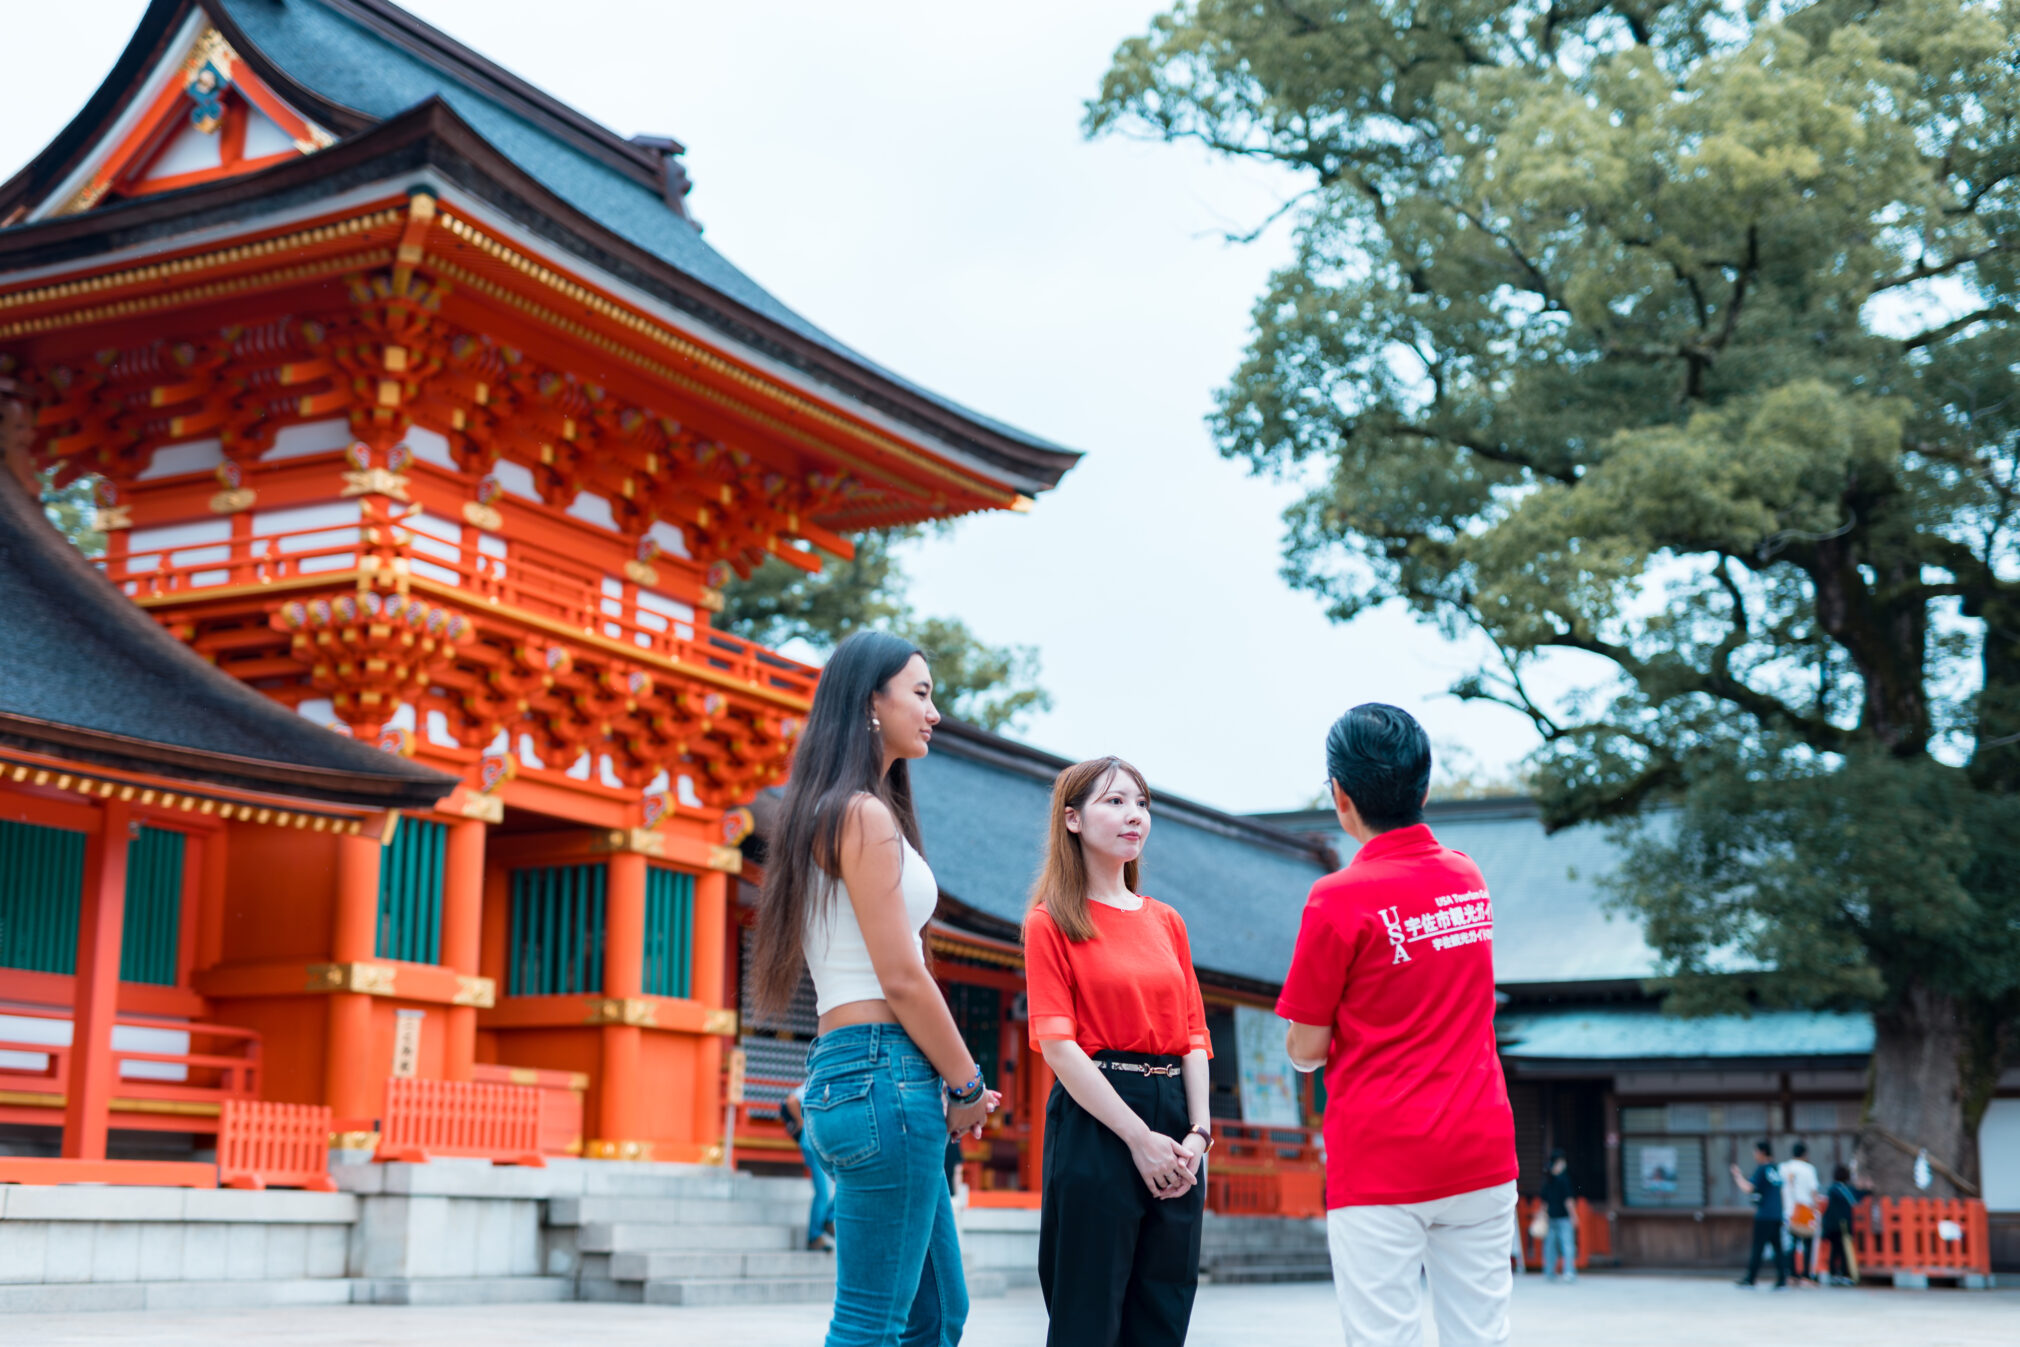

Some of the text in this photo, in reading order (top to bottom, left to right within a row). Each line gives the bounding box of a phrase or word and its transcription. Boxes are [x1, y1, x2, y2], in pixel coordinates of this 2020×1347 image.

[1435, 895, 1454, 907] USA
[1451, 890, 1480, 903] Tourism
[1377, 905, 1412, 965] USA
[1404, 901, 1493, 937] 宇佐市観光ガイ
